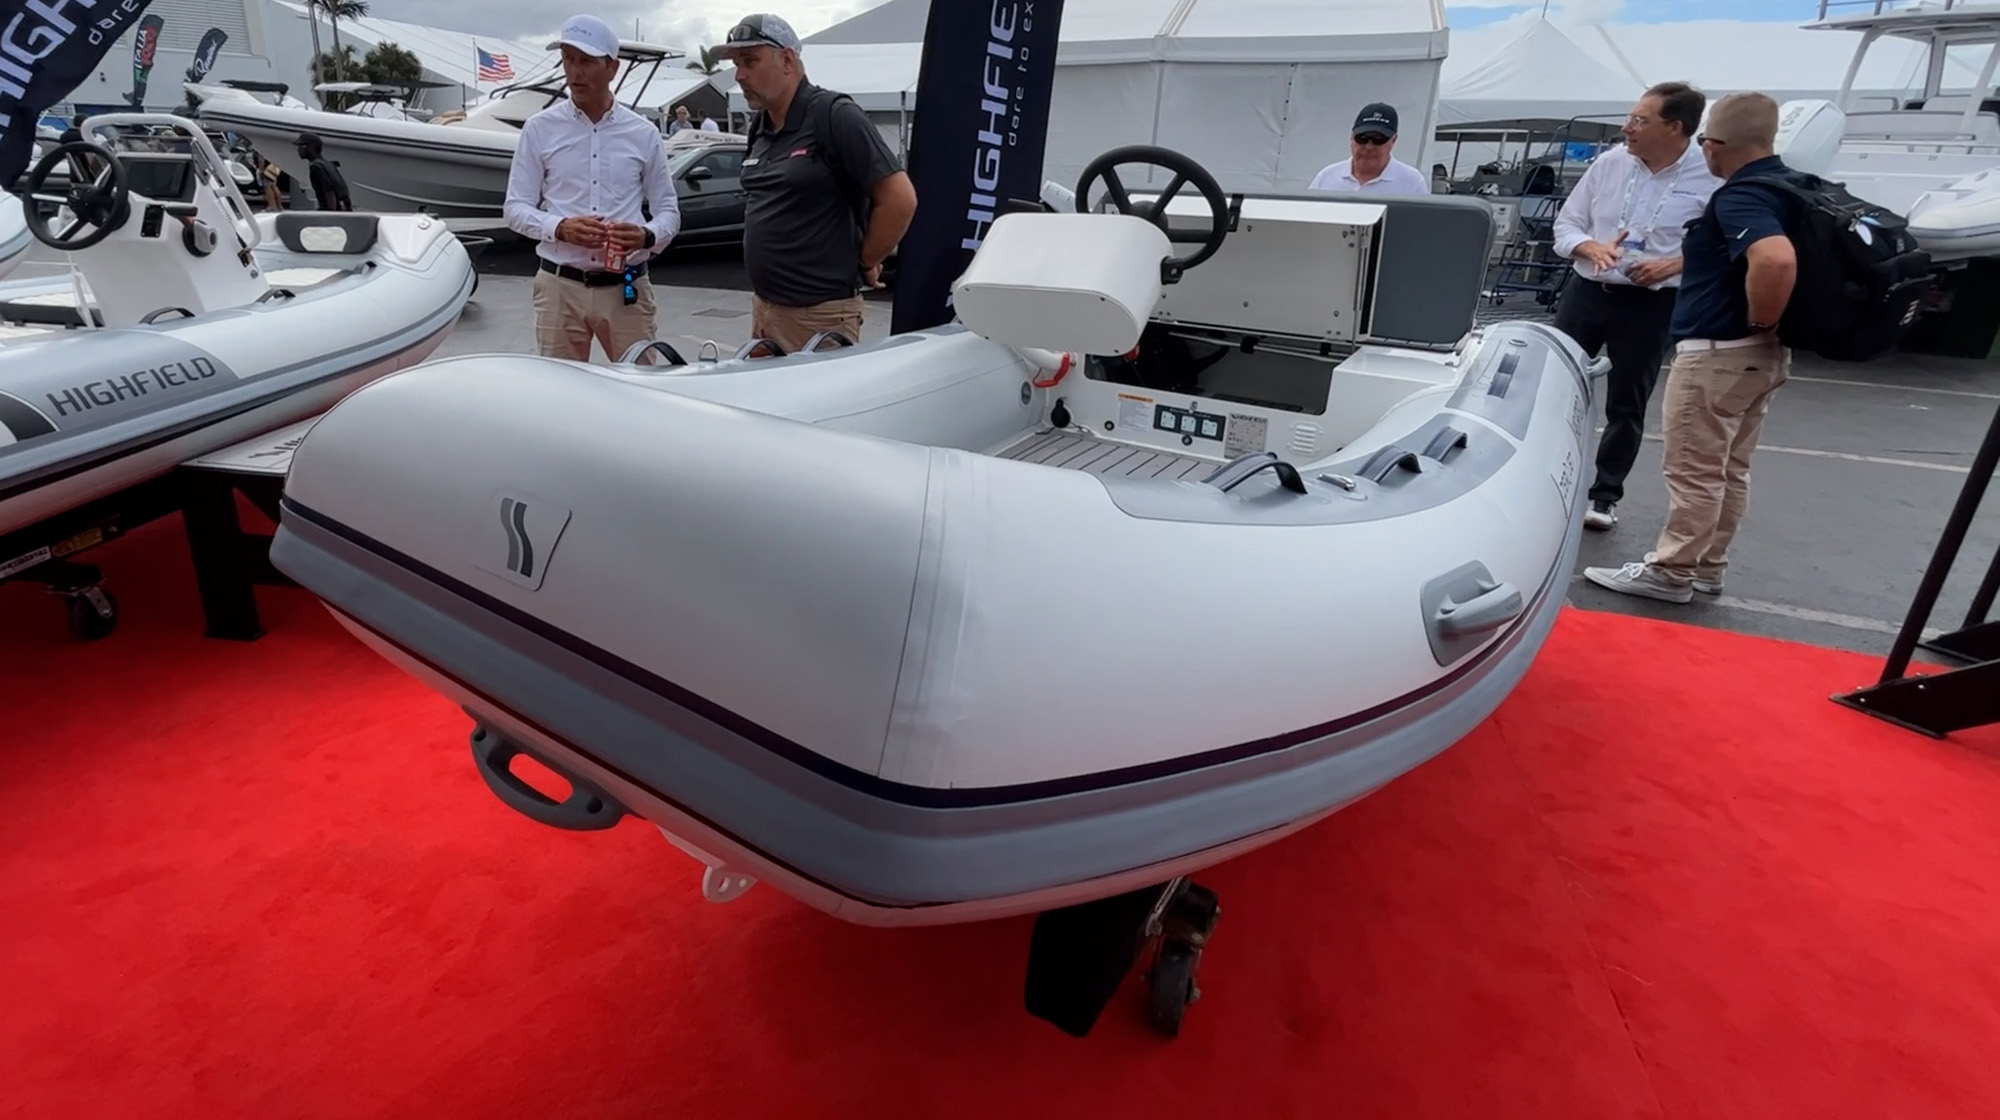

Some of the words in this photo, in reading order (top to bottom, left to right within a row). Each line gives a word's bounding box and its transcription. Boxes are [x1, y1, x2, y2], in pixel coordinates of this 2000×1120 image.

[88, 0, 140, 45] dare
[1008, 86, 1024, 147] dare
[1017, 47, 1030, 72] to
[46, 356, 216, 416] HIGHFIELD
